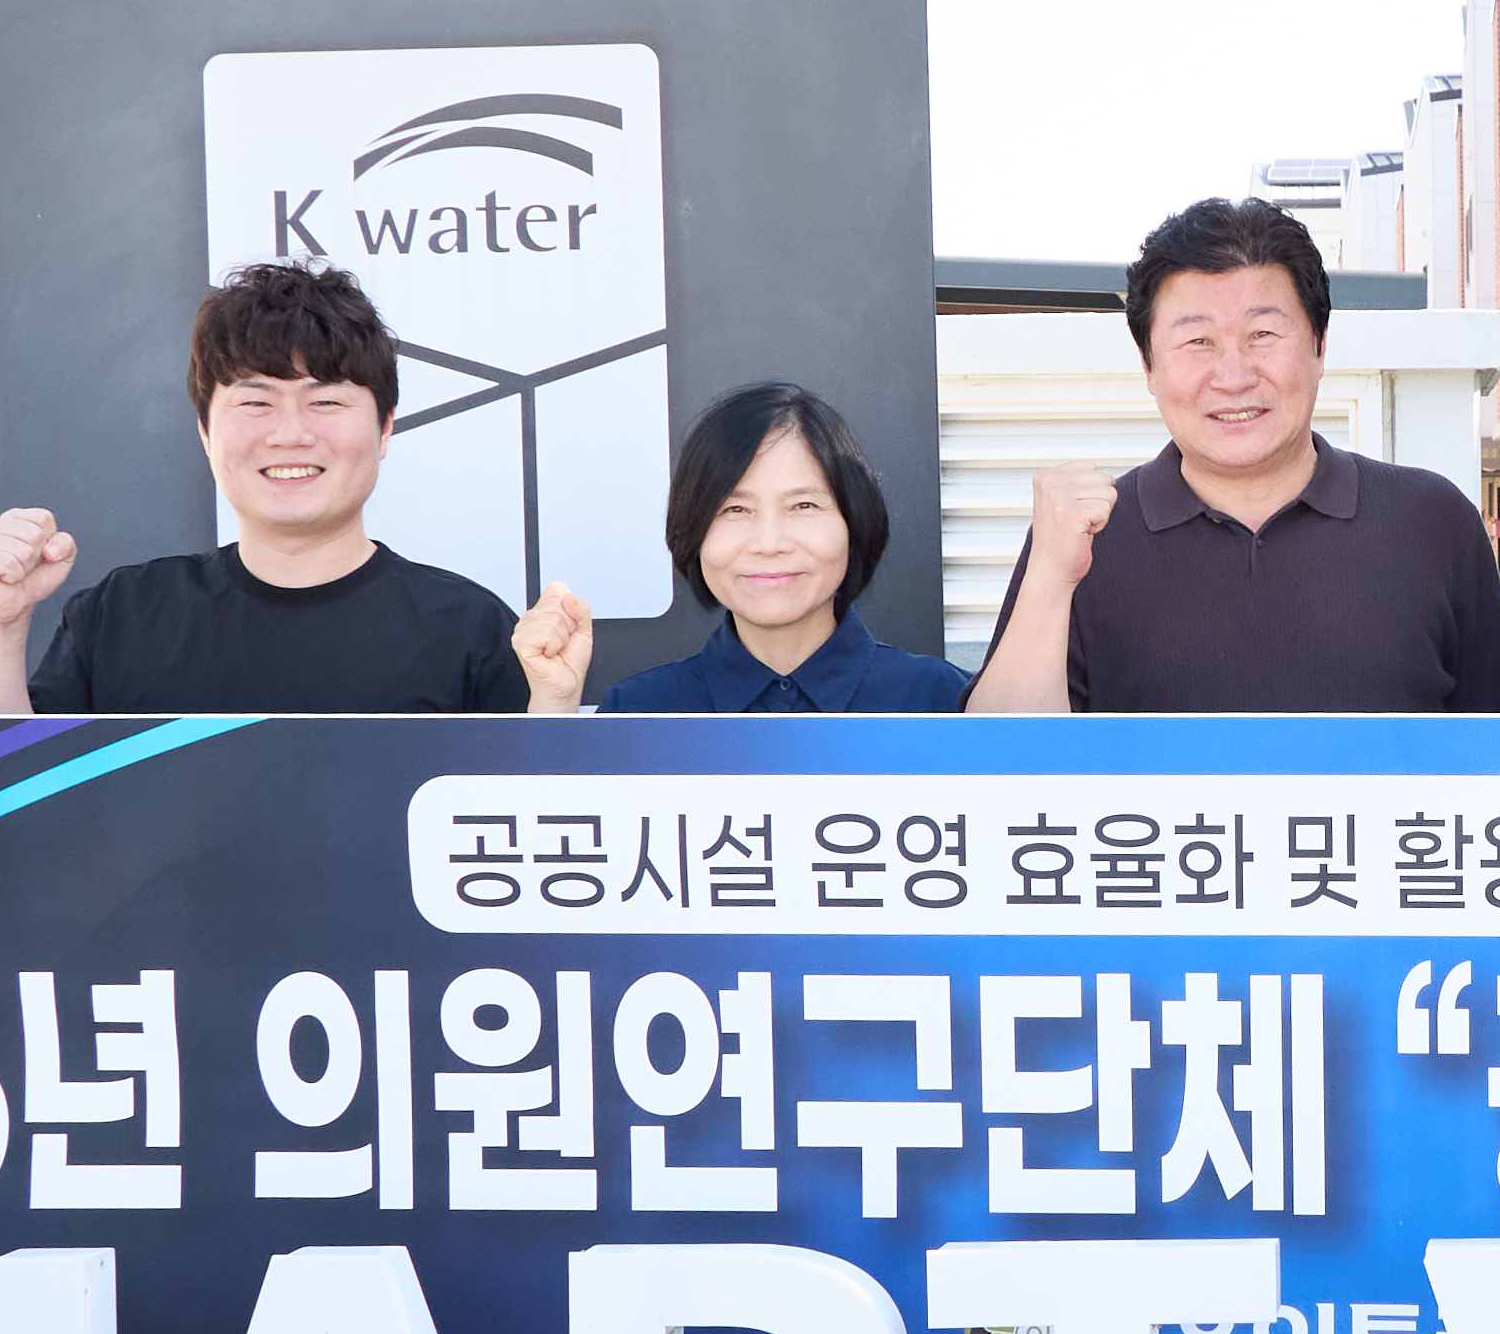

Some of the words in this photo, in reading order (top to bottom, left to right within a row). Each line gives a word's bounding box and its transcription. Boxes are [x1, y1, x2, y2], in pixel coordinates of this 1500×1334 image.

[274, 189, 328, 257] K
[354, 190, 597, 255] water
[448, 814, 778, 909] 공공시설
[811, 813, 969, 909] 운영
[1006, 812, 1254, 910] 효율화
[1287, 815, 1359, 910] 및
[254, 968, 1326, 1218] 의원연구단체
